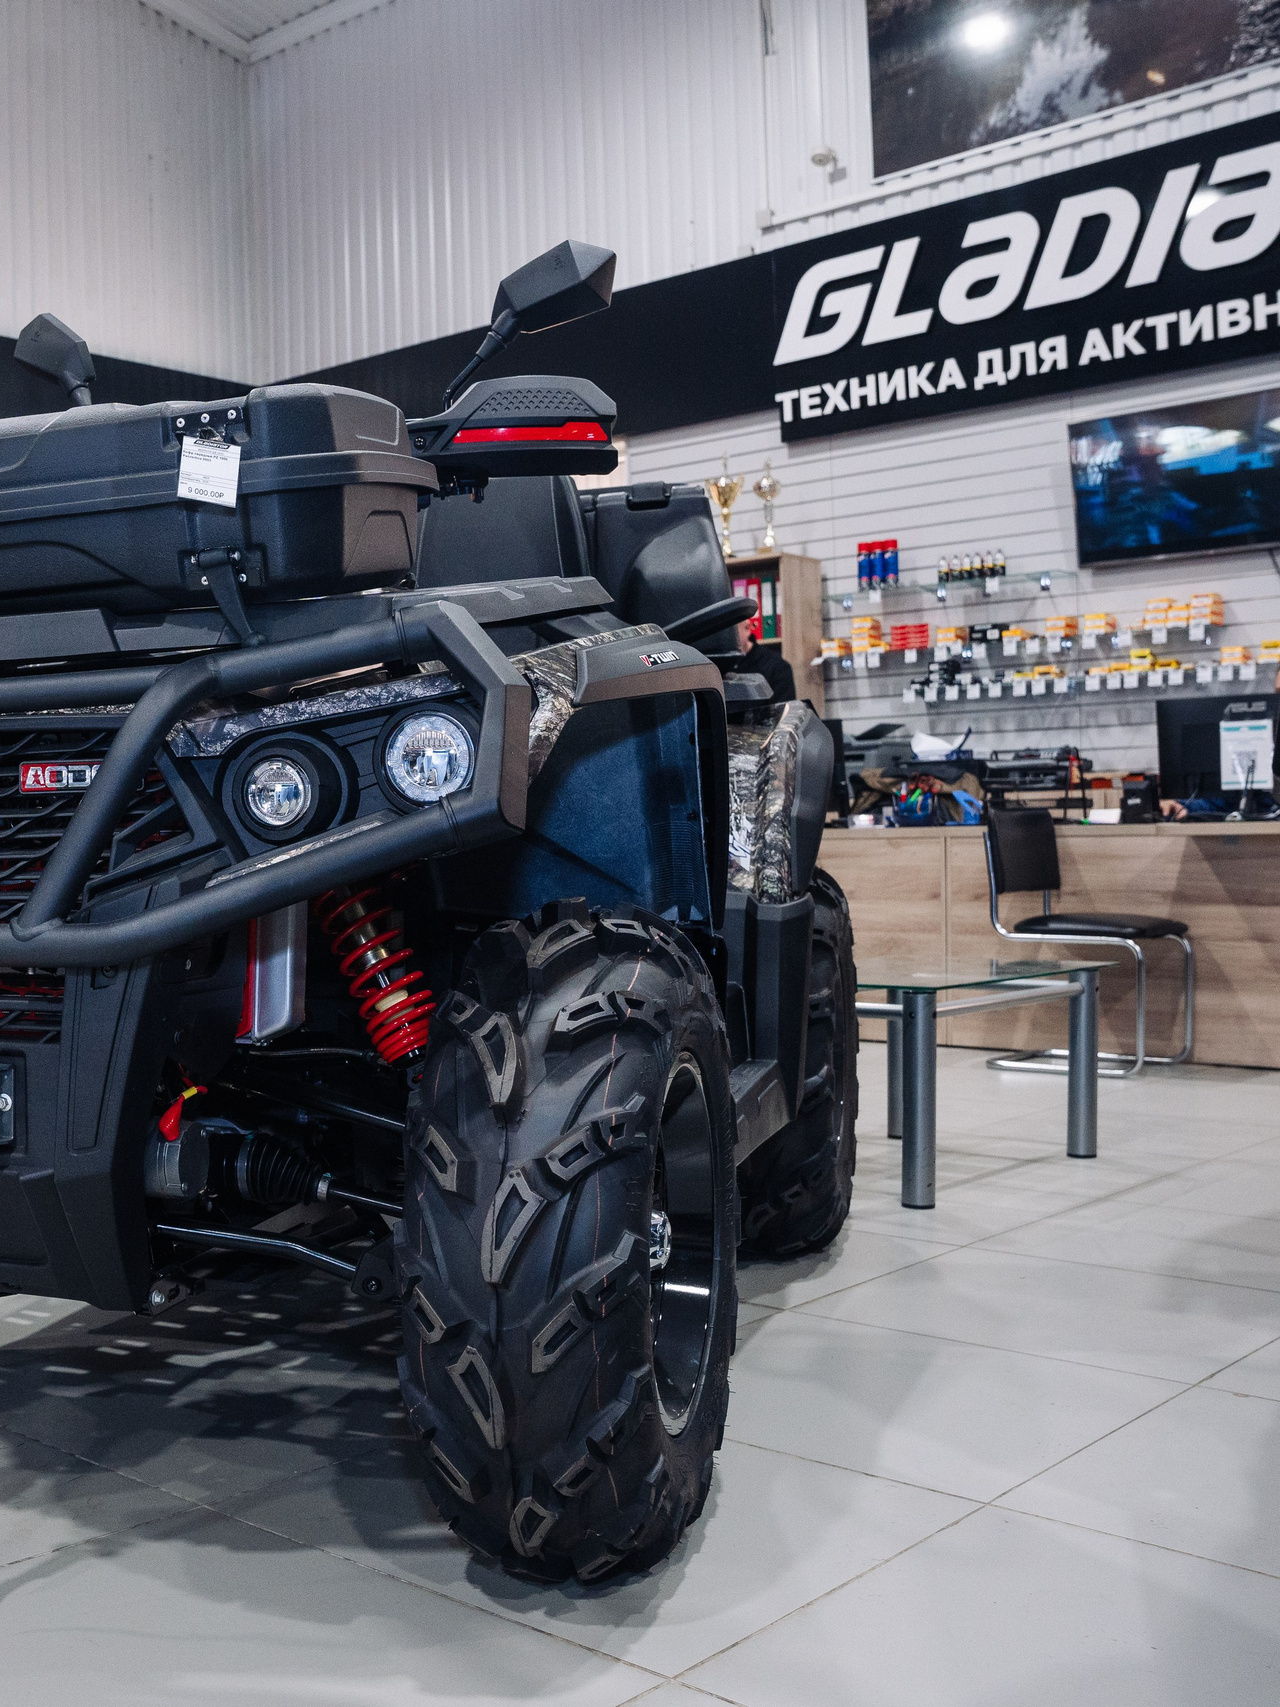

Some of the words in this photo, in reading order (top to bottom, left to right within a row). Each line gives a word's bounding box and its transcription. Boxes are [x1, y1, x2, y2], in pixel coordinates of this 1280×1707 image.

[775, 356, 968, 423] ТЕХНИКА
[974, 334, 1069, 390] ДЛЯ
[187, 486, 193, 494] 9
